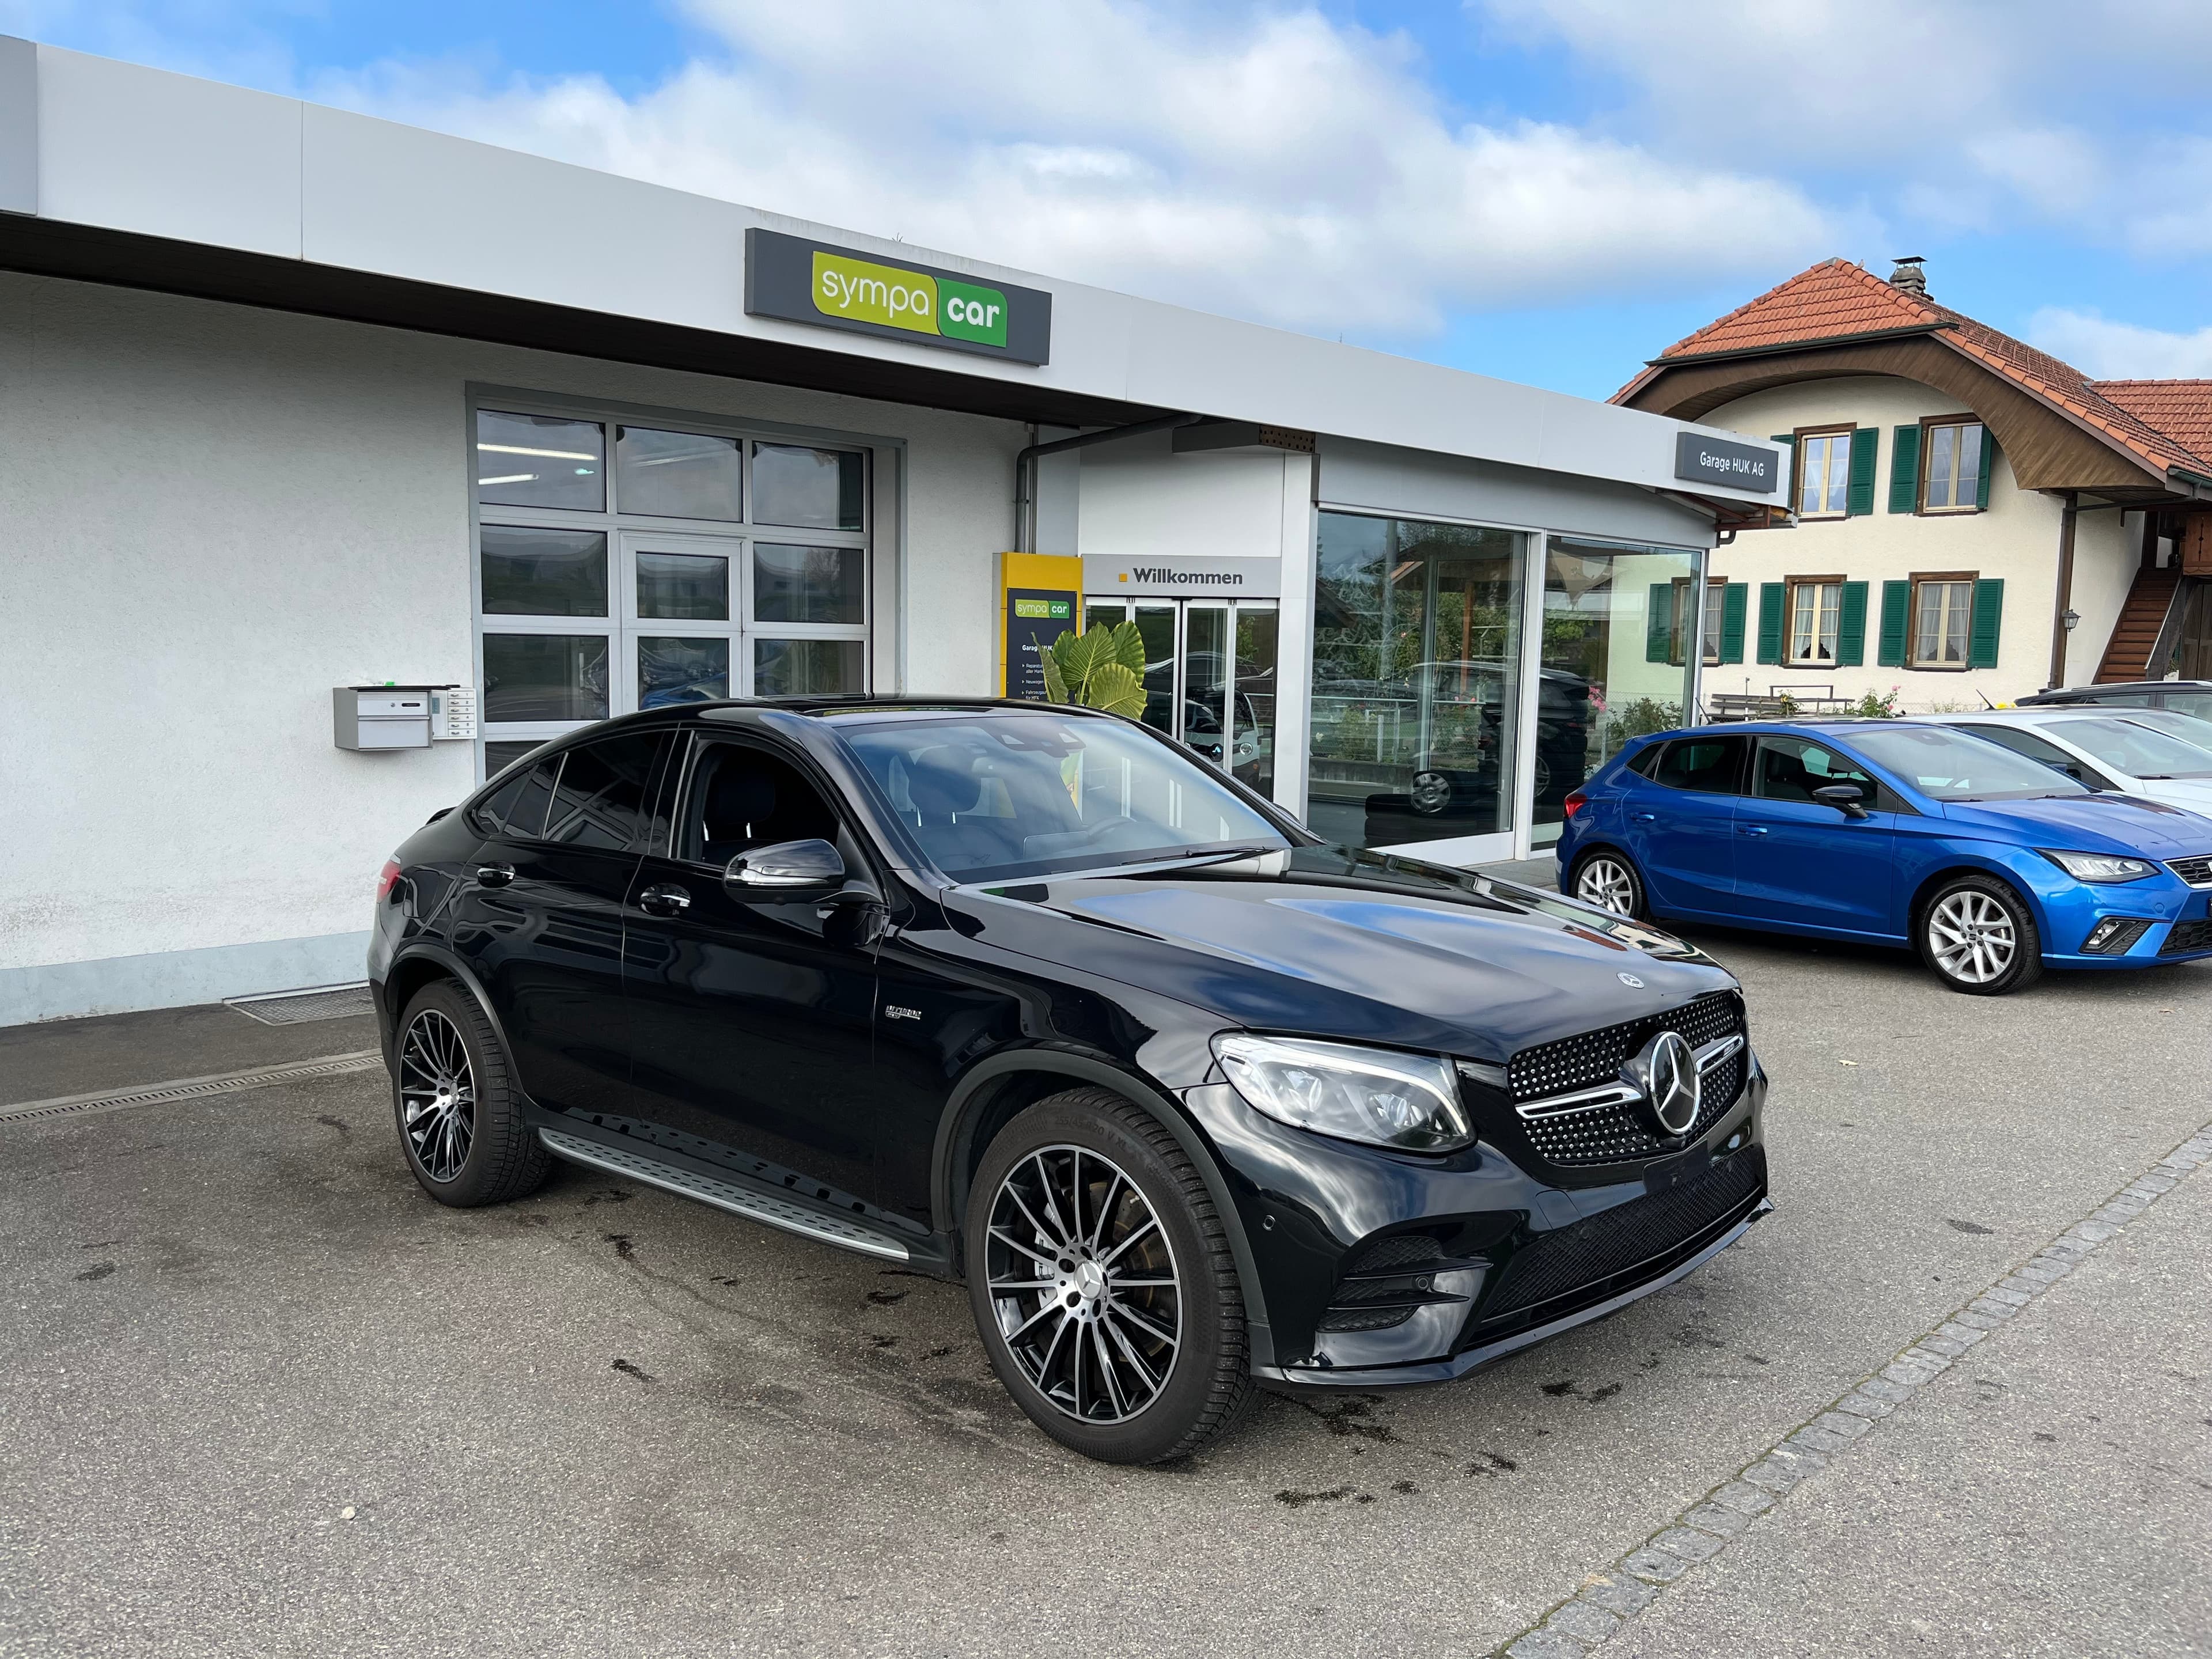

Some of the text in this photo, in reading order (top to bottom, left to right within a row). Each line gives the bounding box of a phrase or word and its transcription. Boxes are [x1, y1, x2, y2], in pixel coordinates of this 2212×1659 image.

[822, 271, 1000, 328] sympa car
[1700, 451, 1764, 476] Garage HUK AG
[1133, 567, 1243, 585] Willkommen
[1017, 604, 1067, 615] sympa car
